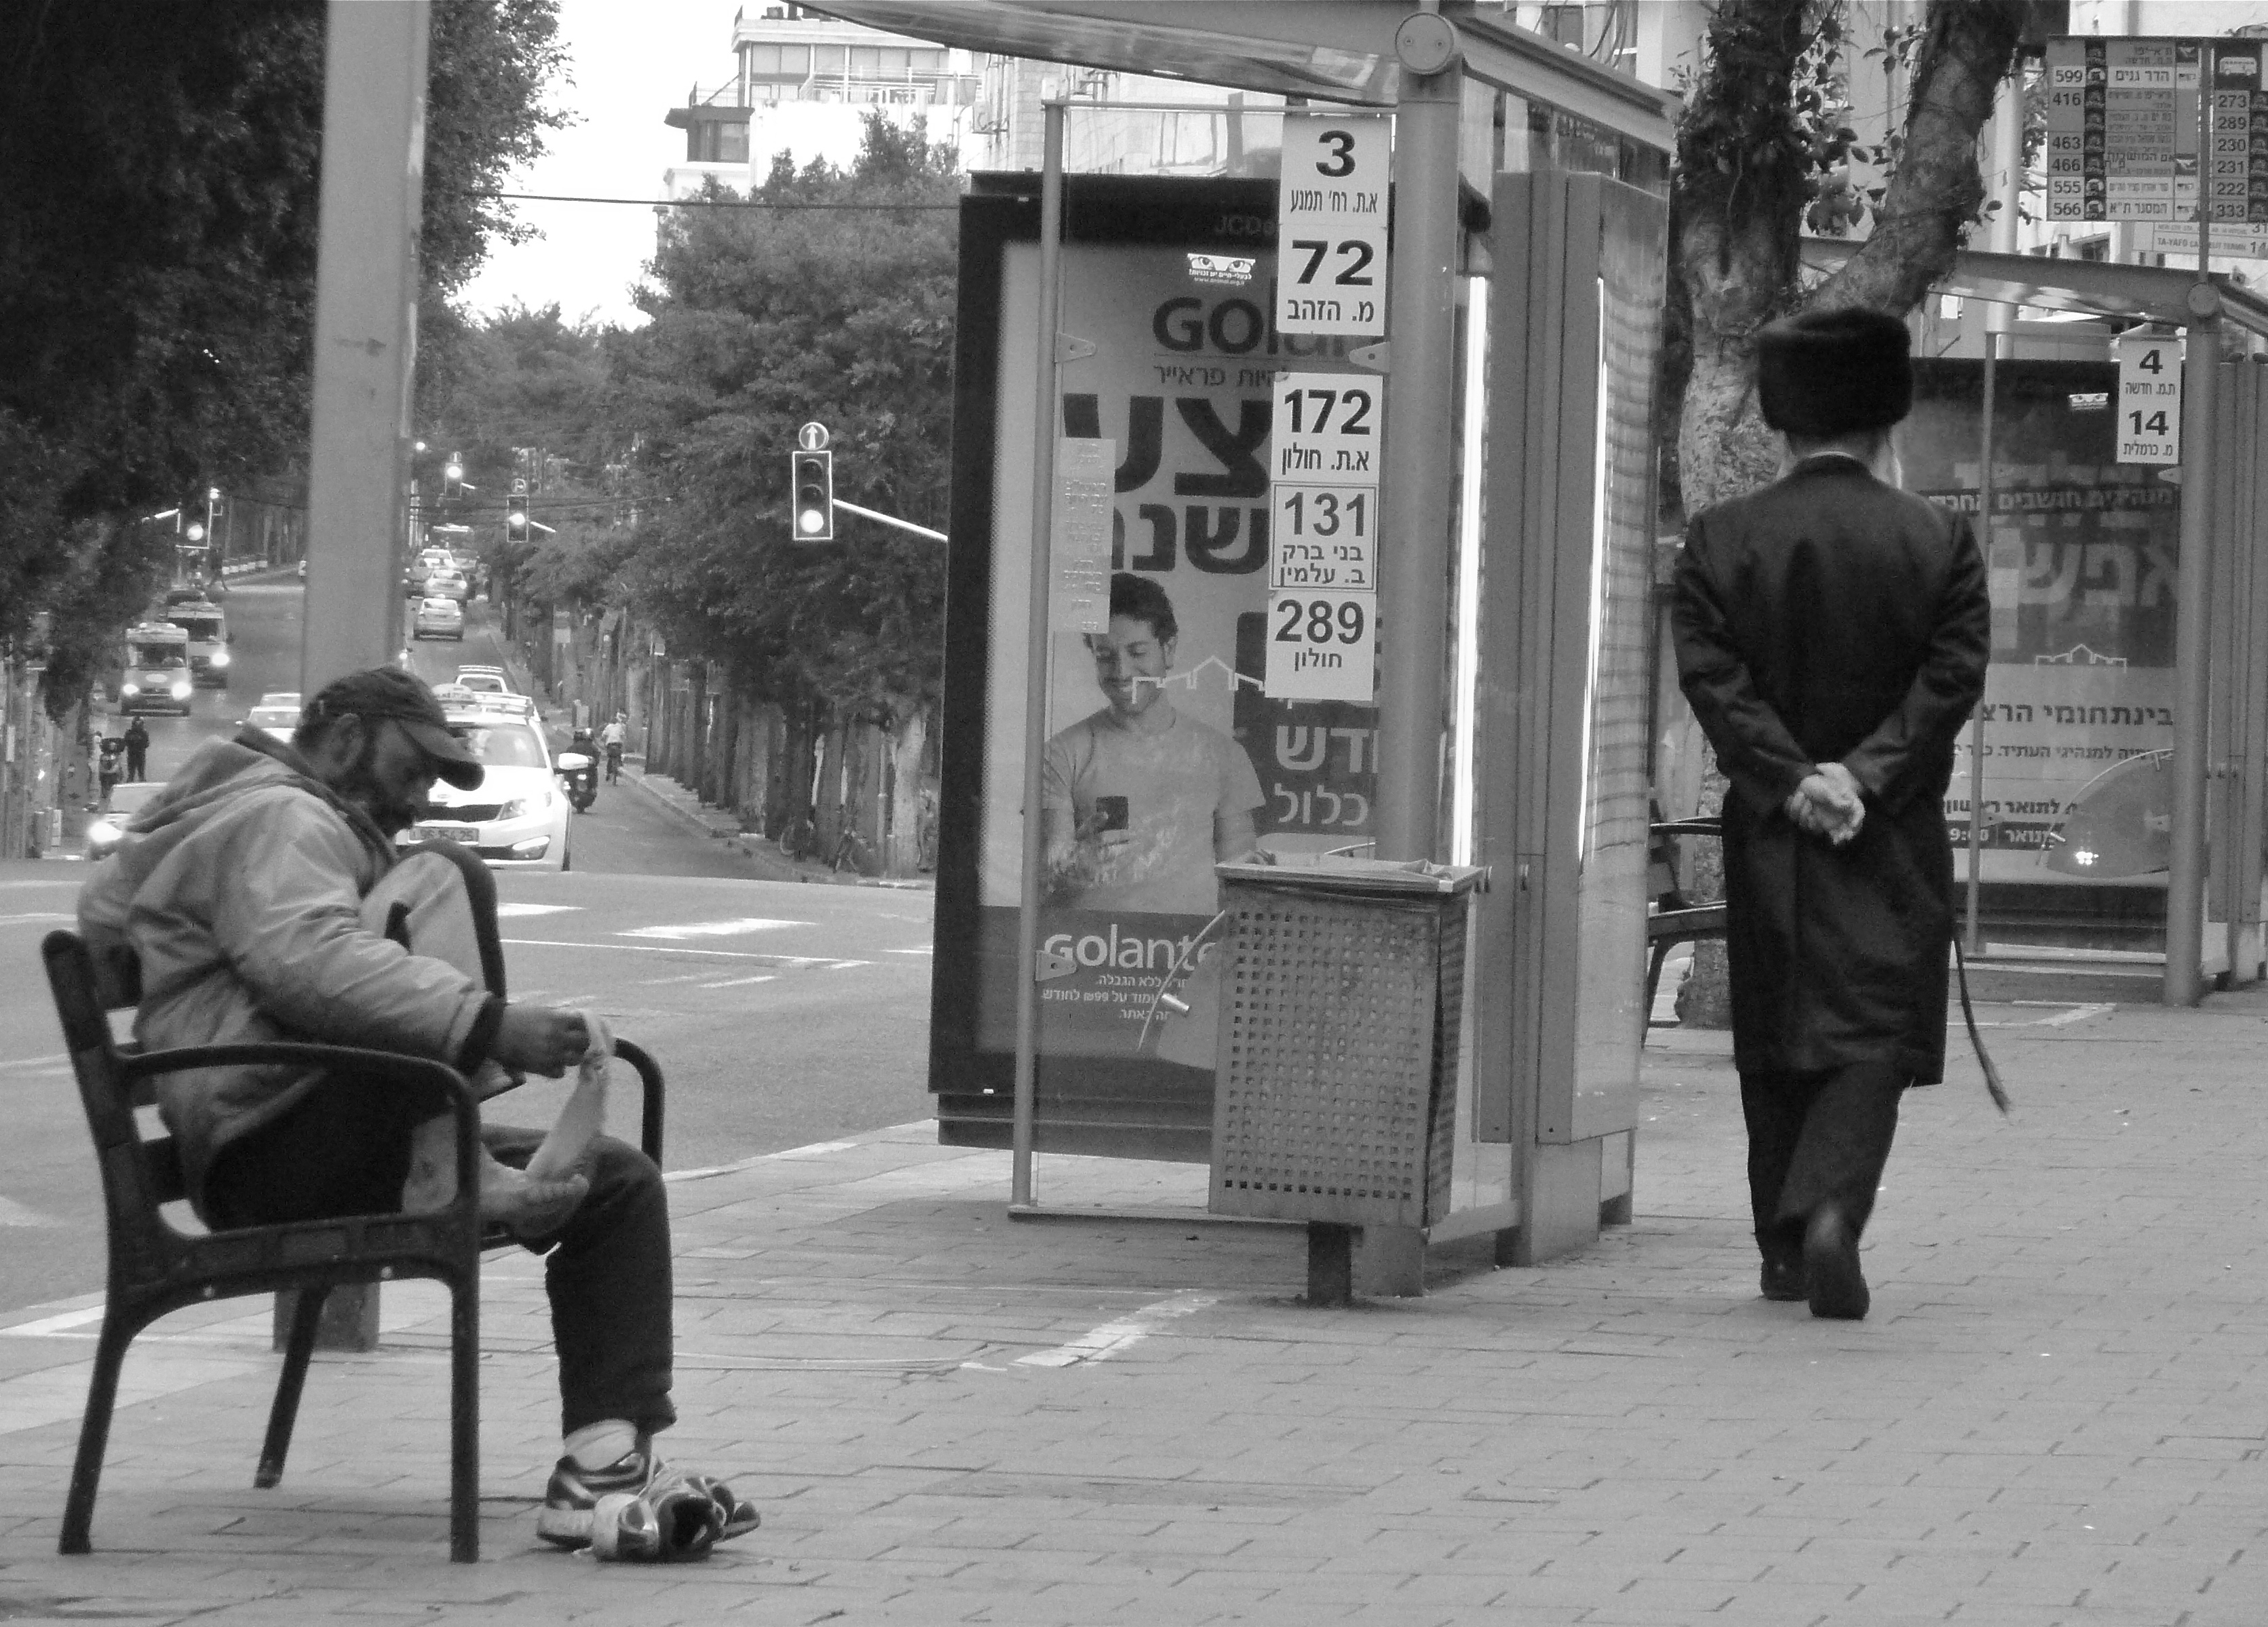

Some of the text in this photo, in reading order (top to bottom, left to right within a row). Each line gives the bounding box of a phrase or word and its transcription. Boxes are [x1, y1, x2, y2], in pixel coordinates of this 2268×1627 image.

[2056, 70, 2083, 83] 599
[2115, 70, 2140, 81] גנים
[2145, 70, 2170, 81] הדר
[2053, 92, 2081, 106] 416
[2218, 95, 2247, 108] 273
[2218, 117, 2246, 130] 289
[2052, 136, 2081, 150] 463
[2217, 138, 2246, 151] 230
[1315, 130, 1356, 177] 3
[2052, 158, 2081, 172] 466
[2217, 160, 2244, 174] 231
[2054, 181, 2081, 193] 555
[2216, 182, 2245, 195] 222
[1290, 190, 1378, 214] א.ת. רח' תמנע
[2054, 202, 2081, 216] 566
[2216, 204, 2245, 218] 333
[1292, 240, 1374, 286] 72
[1287, 299, 1375, 322] מ. הזהב
[2139, 349, 2164, 375] 4
[1153, 366, 1226, 387] פראייר
[2125, 382, 2152, 395] חדשה
[1284, 388, 1371, 436] 172
[2129, 410, 2169, 436] 14
[2123, 440, 2159, 456] כרמלית
[1282, 442, 1369, 475] א.ת. חולון
[1285, 492, 1364, 537] 131
[1283, 545, 1364, 564] בני ברק
[1280, 563, 1365, 587] ב. עלמין
[1275, 599, 1364, 645] 289
[1294, 648, 1342, 671] חולון
[1274, 783, 1368, 826] כלול
[2005, 798, 2060, 814] לתואר
[1042, 989, 1080, 1001] לחודש
[1112, 991, 1127, 1003] על
